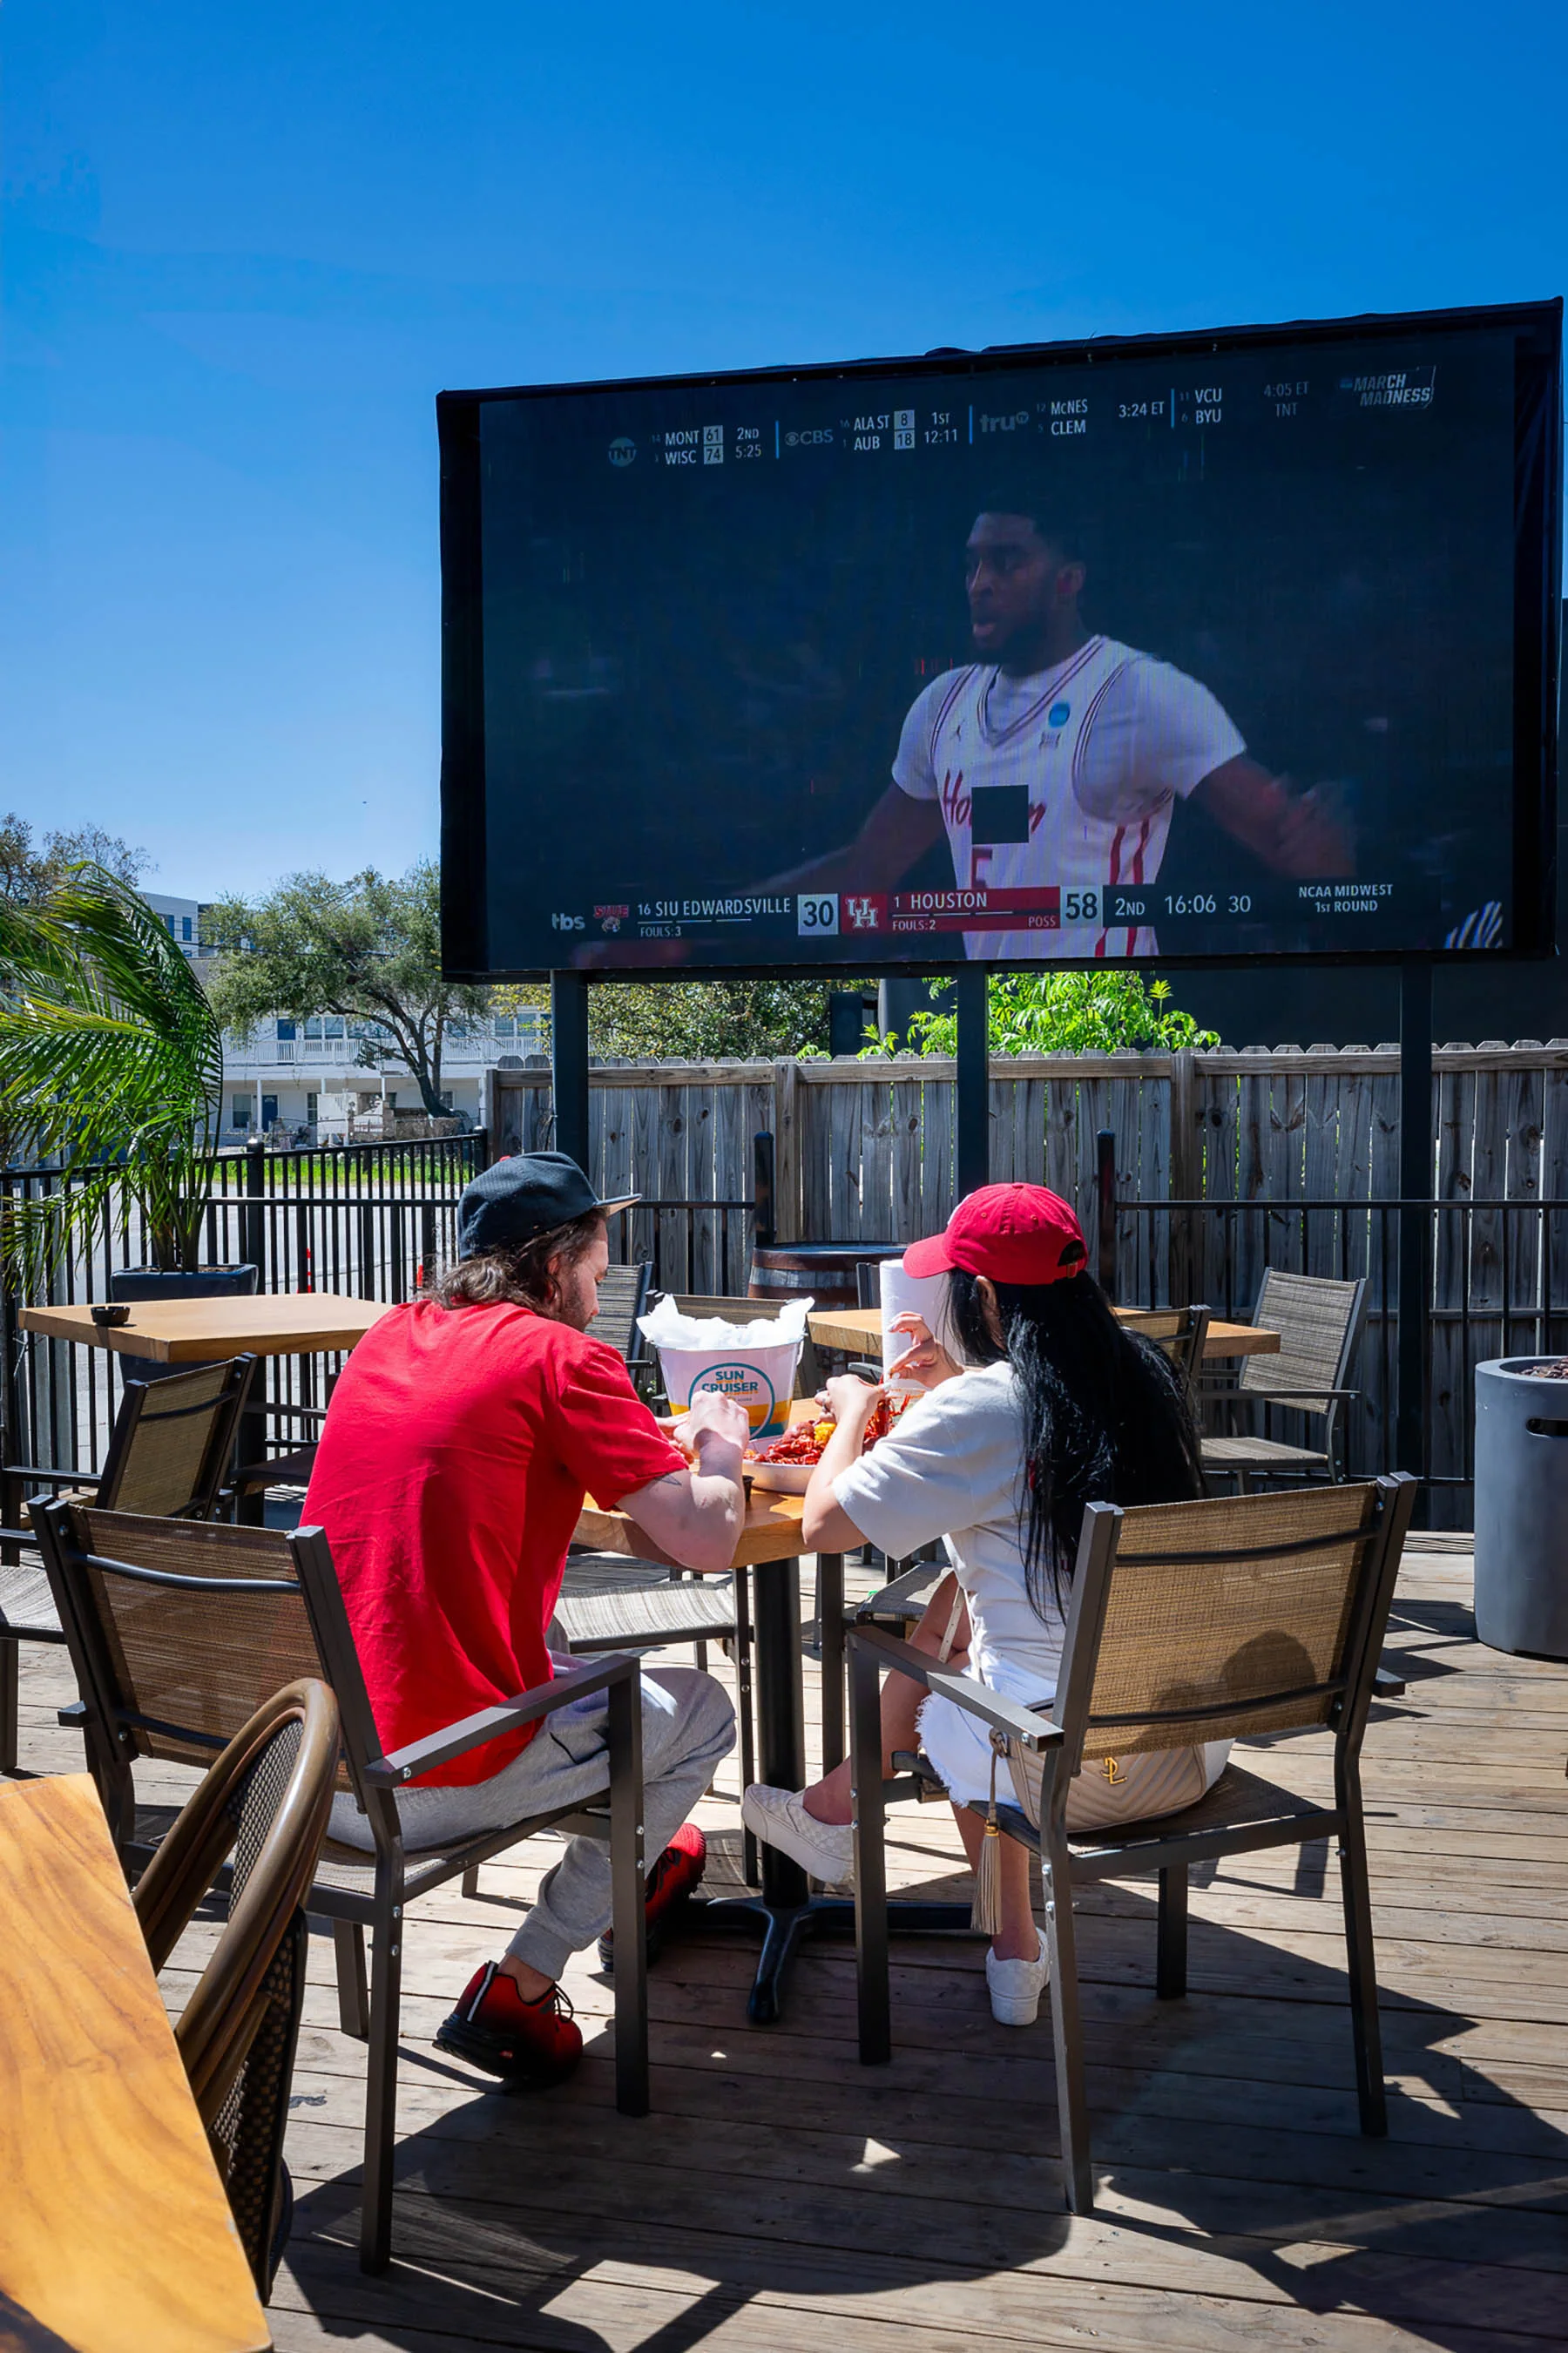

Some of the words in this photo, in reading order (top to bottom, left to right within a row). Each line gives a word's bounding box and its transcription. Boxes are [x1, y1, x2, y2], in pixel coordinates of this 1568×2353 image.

[1353, 373, 1407, 392] MARCH
[1194, 388, 1222, 404] VCU
[1359, 387, 1431, 407] MADNESS
[1118, 402, 1147, 418] 3:24
[1151, 401, 1165, 416] ET
[1195, 408, 1222, 424] BYU
[923, 428, 958, 444] 12:11
[1051, 419, 1086, 436] CLEM
[665, 429, 700, 446] MONT
[706, 428, 720, 442] 61
[800, 429, 834, 446] CBS
[854, 436, 881, 451] AUB
[896, 432, 913, 447] 18
[665, 450, 697, 466] WISC
[706, 448, 720, 462] 74
[735, 444, 762, 459] 5:25
[1298, 885, 1332, 899] NCAA
[1334, 883, 1394, 897] MIDWEST
[638, 903, 652, 916] 16
[655, 899, 679, 917] SIU
[683, 897, 792, 916] EDWARDSVILLE
[894, 896, 900, 909] 1
[910, 892, 988, 909] HOUSTON
[1064, 892, 1098, 921] 58
[1164, 894, 1217, 916] 16:06
[1227, 895, 1252, 914] 30
[1333, 900, 1378, 913] ROUND
[551, 913, 586, 931] tbs
[802, 900, 834, 927] 30
[1028, 915, 1057, 928] POSS
[715, 1370, 744, 1381] SUN
[701, 1382, 758, 1393] CRUISER
